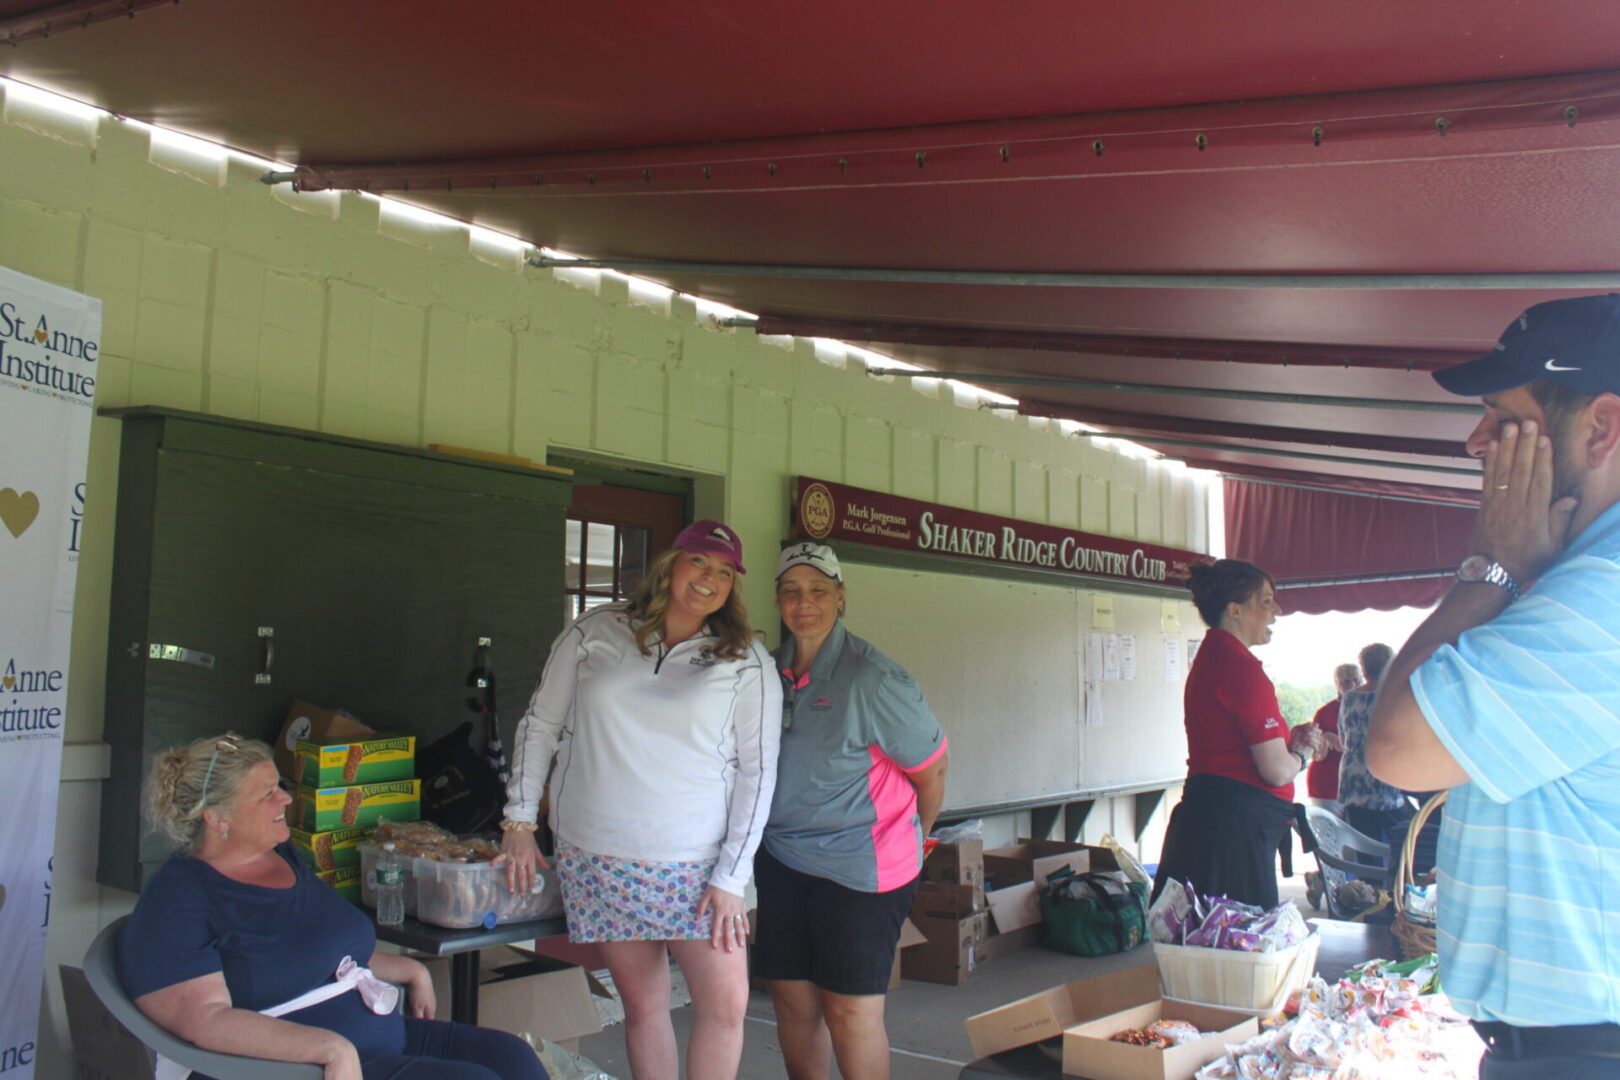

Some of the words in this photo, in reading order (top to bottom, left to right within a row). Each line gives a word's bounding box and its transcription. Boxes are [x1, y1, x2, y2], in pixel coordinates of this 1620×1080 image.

[0, 339, 95, 397] Institute
[808, 505, 828, 517] PGA
[847, 502, 870, 519] Mark
[870, 507, 907, 526] Jorgensen
[1000, 526, 1057, 567] RIDGE
[1060, 536, 1130, 576] COUNTRY
[1132, 549, 1167, 581] CLUB
[0, 699, 61, 732] titute
